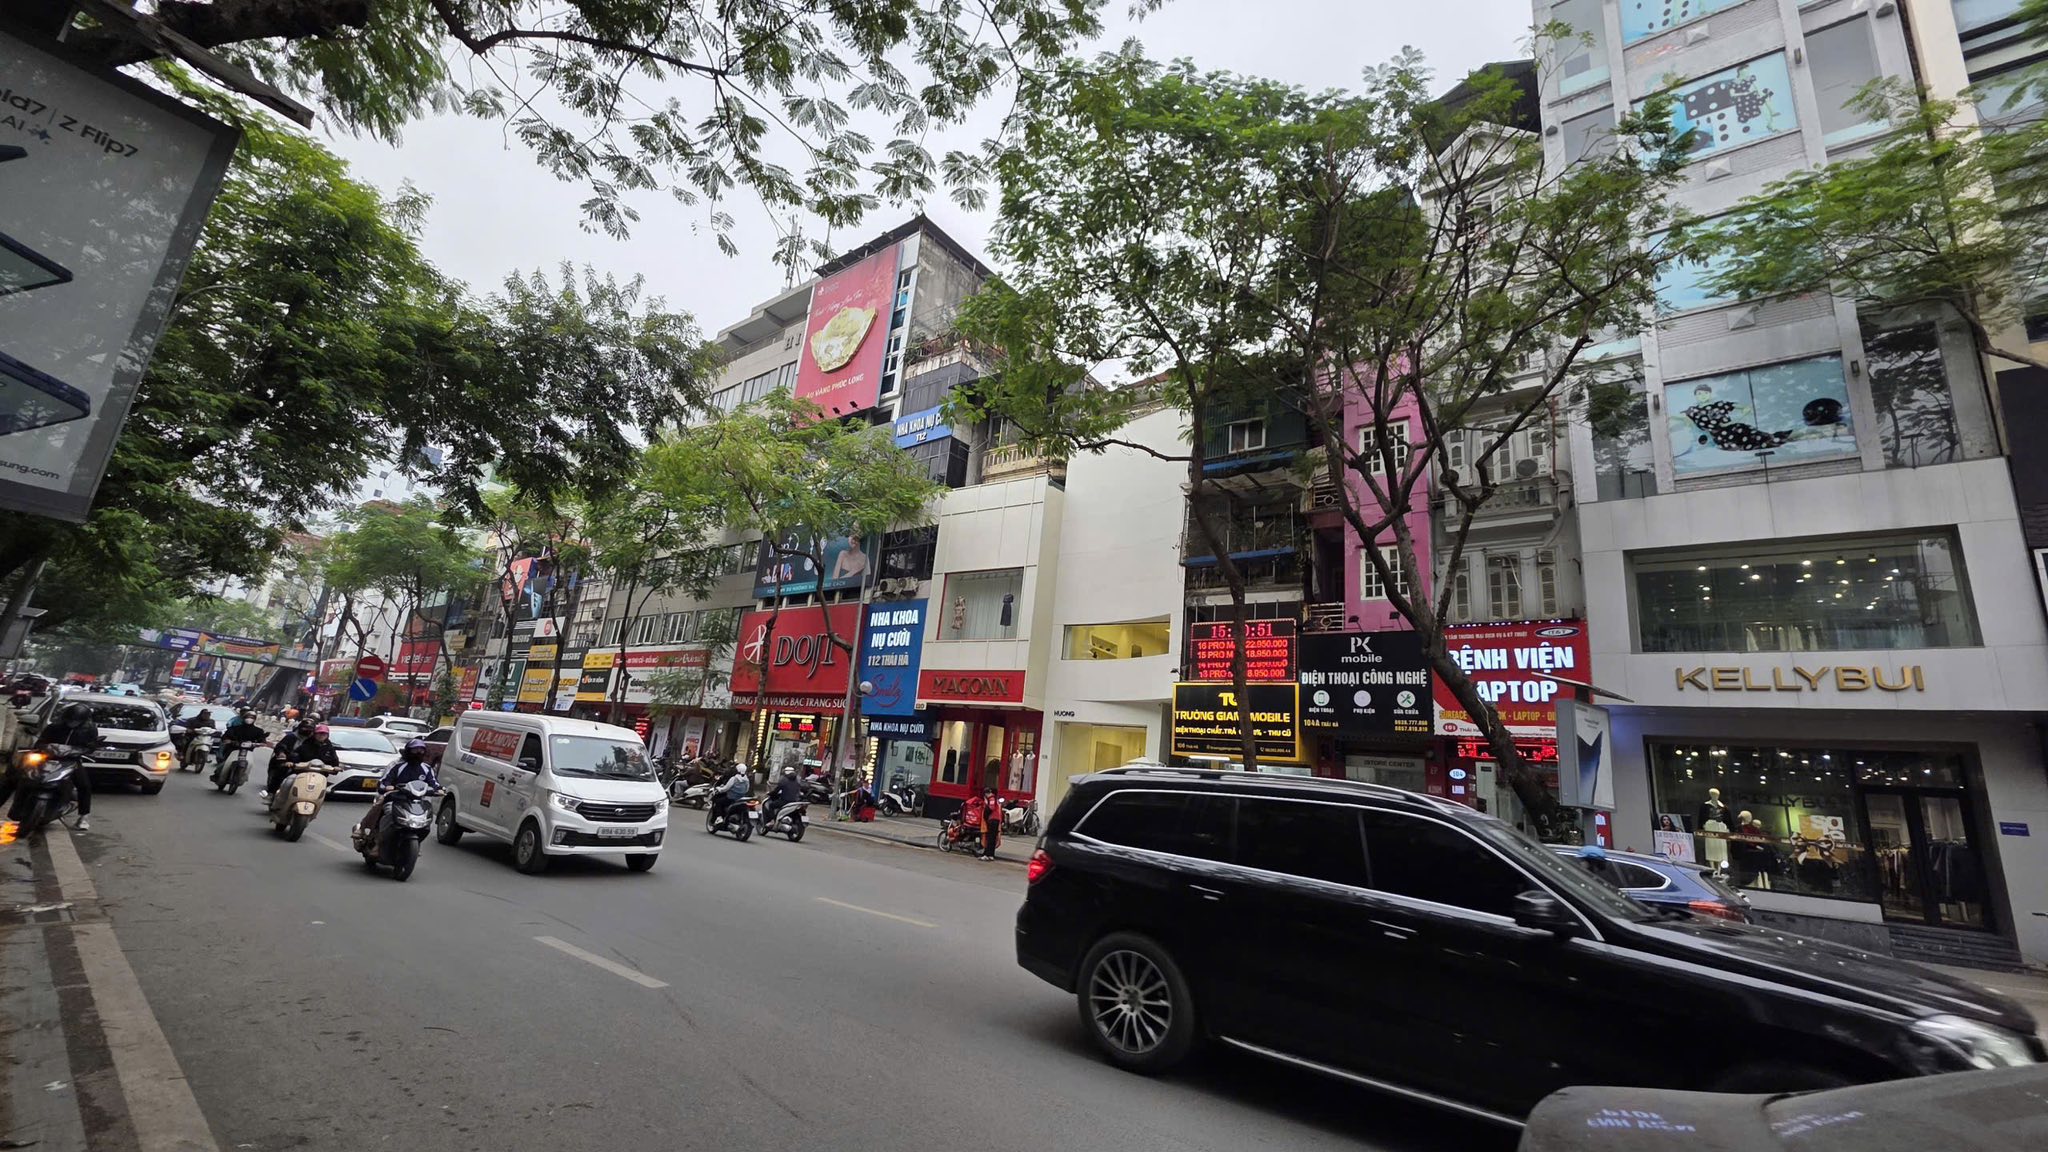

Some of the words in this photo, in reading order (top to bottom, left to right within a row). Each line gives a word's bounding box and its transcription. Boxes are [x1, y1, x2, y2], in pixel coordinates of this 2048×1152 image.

[0, 88, 47, 115] ld7
[58, 115, 78, 132] Z
[80, 124, 139, 157] Flip7
[870, 611, 890, 627] NHA
[892, 609, 919, 625] KHOA
[1211, 623, 1273, 638] 15::51
[871, 632, 885, 650] NỤ
[887, 628, 911, 647] CƯỜI
[1208, 641, 1225, 649] PRO
[1350, 636, 1373, 653] PK
[773, 633, 840, 679] DOJI
[867, 655, 881, 667] 112
[1207, 650, 1225, 658] PRO
[1341, 653, 1383, 663] mobile
[1514, 641, 1574, 673] VIỆN
[1209, 669, 1227, 678] PRO
[1301, 669, 1325, 687] ĐIỆN
[1328, 671, 1360, 687] THOẠI
[1362, 668, 1393, 685] CÔNG
[1396, 668, 1428, 687] NGHỆ
[1676, 665, 1925, 692] KELLYBUI
[1477, 680, 1558, 702] APTOP
[732, 695, 753, 705] TRUNG
[806, 697, 831, 709] TRANG
[1216, 711, 1240, 721] GIAN
[1250, 712, 1291, 723] MOBILE
[1513, 711, 1541, 721] LAPTOP
[870, 721, 882, 731] NHA
[883, 722, 899, 732] KHOA
